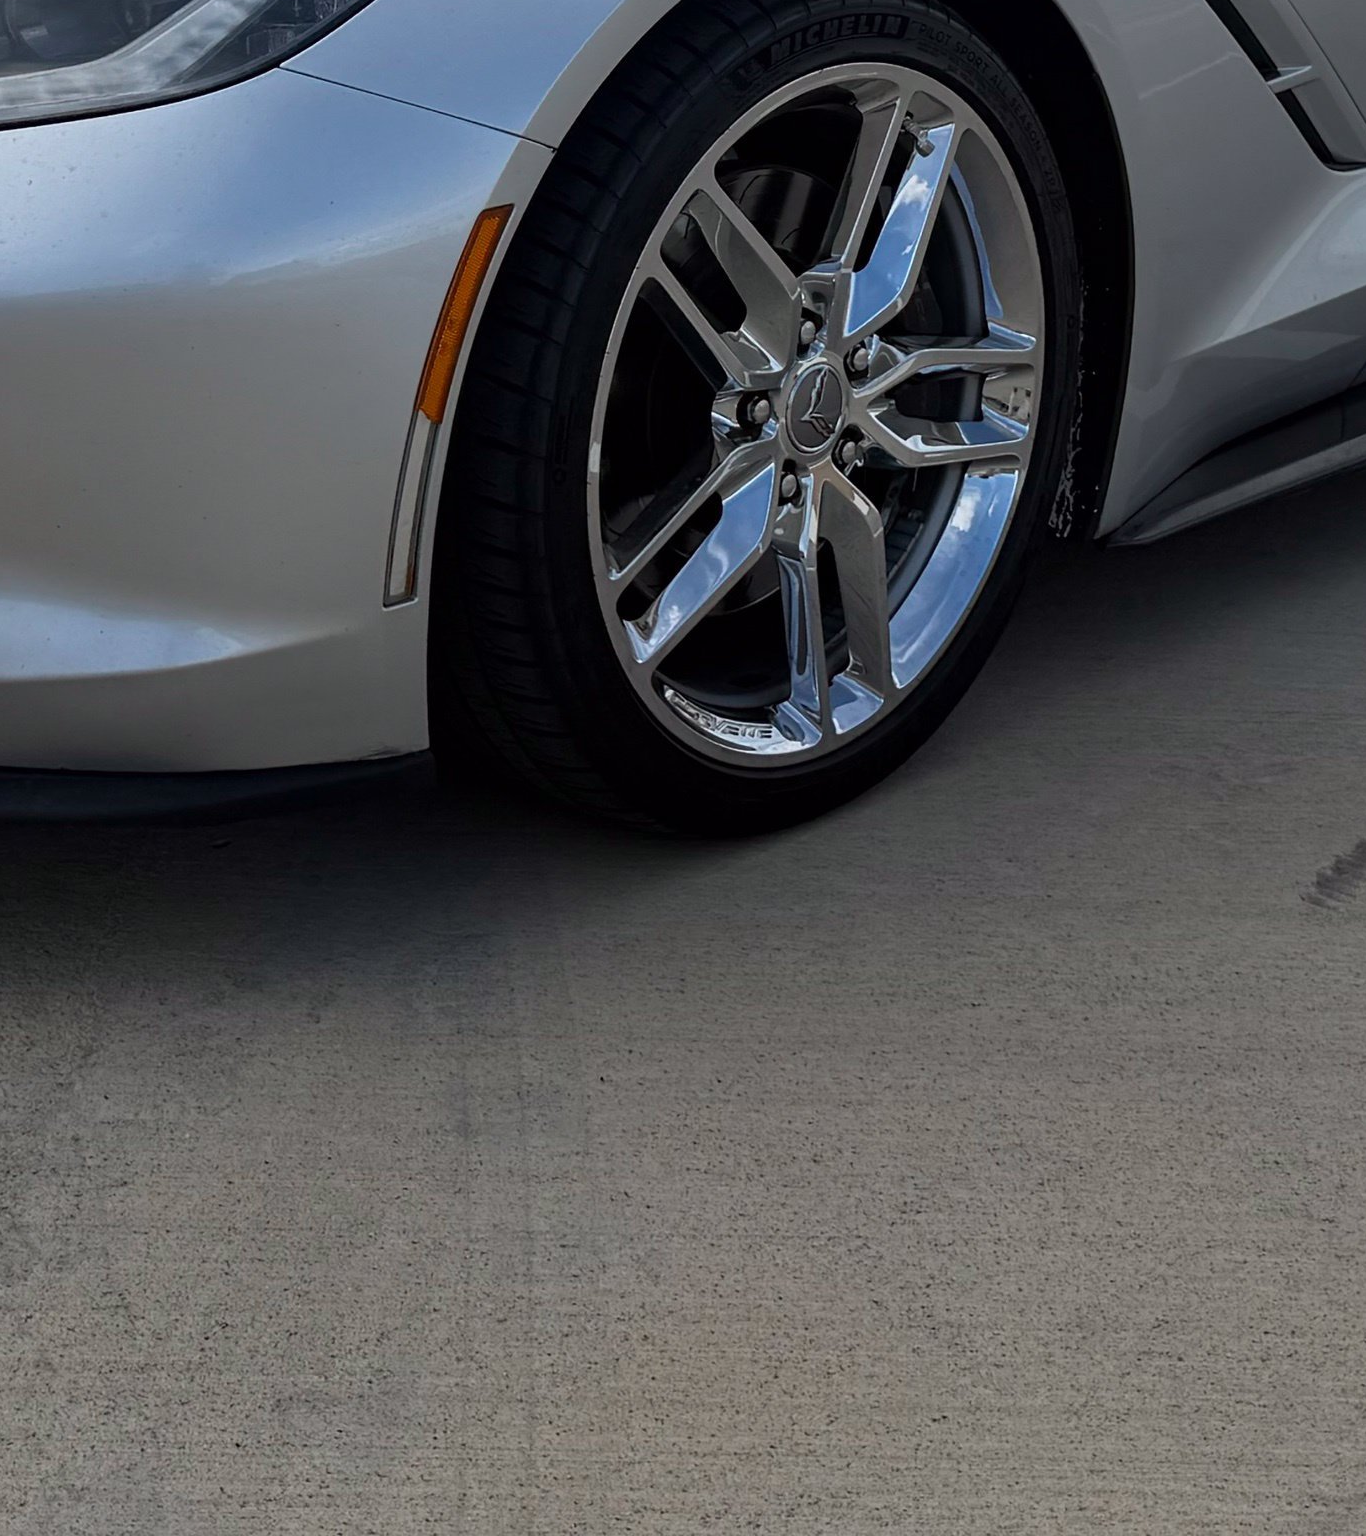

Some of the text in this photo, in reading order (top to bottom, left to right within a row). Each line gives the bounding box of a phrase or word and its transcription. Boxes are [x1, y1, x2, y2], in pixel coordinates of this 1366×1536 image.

[770, 15, 903, 65] MICHELIN
[919, 23, 952, 45] PILOT
[955, 41, 989, 73] SPORT
